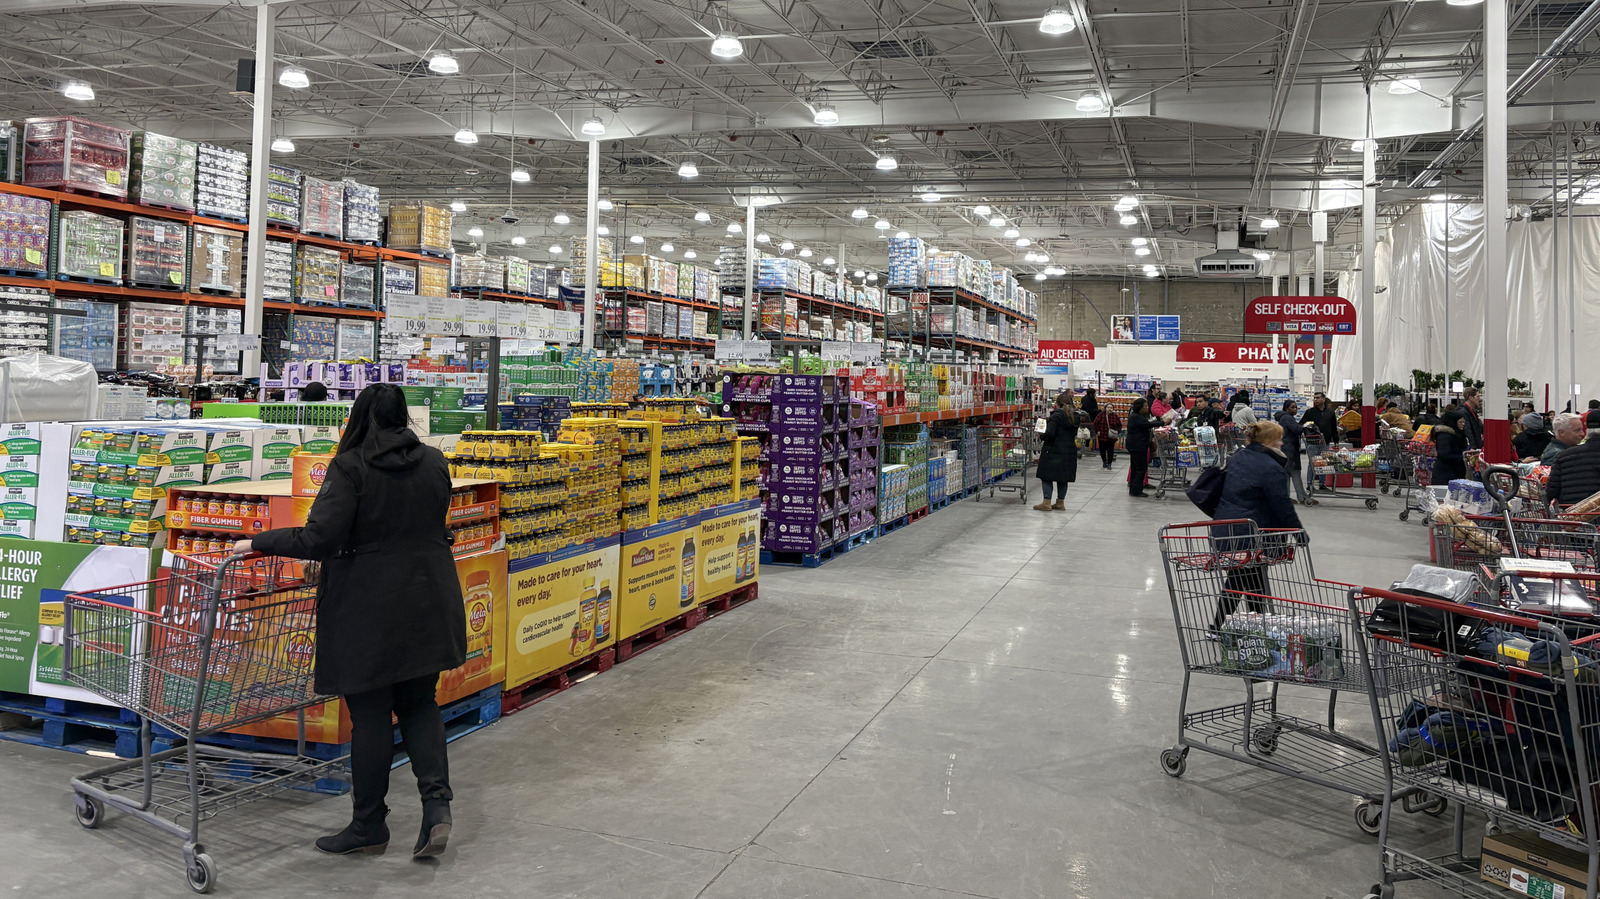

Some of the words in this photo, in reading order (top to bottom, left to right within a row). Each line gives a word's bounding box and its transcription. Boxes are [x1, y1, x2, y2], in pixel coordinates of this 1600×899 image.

[1254, 303, 1281, 314] SELF
[1283, 304, 1346, 316] CHECK-OUT
[406, 320, 426, 332] 19.99
[443, 322, 462, 332] 29.99
[478, 324, 495, 334] 19.99
[510, 326, 526, 336] 17.99
[566, 332, 579, 340] 13.99
[1040, 349, 1054, 358] AID
[1056, 349, 1090, 358] CENTER
[465, 506, 484, 514] GUMMIES
[211, 517, 242, 526] GUMMIES
[702, 523, 715, 534] Made
[716, 522, 721, 530] to
[721, 520, 731, 528] care
[738, 515, 747, 526] your
[748, 513, 759, 522] heart,
[466, 540, 485, 550] GUMMIES
[702, 536, 715, 546] every
[708, 556, 716, 565] Help
[717, 552, 731, 562] support
[518, 577, 536, 591] Made
[538, 574, 545, 584] to
[546, 571, 560, 582] care
[562, 567, 570, 578] for
[572, 563, 585, 576] your
[586, 558, 603, 569] heart,
[628, 575, 645, 584] Supports
[646, 570, 658, 579] muscle
[659, 565, 676, 574] relaxation,
[707, 566, 721, 576] healthy
[664, 574, 674, 582] health
[517, 593, 536, 607] every
[470, 610, 486, 622] Meta
[523, 625, 533, 634] Daily
[534, 620, 547, 630] CoQ10
[553, 616, 562, 625] help
[562, 610, 576, 620] support
[523, 627, 551, 643] cardiovascular
[552, 623, 564, 632] health
[1240, 647, 1269, 660] Spring
